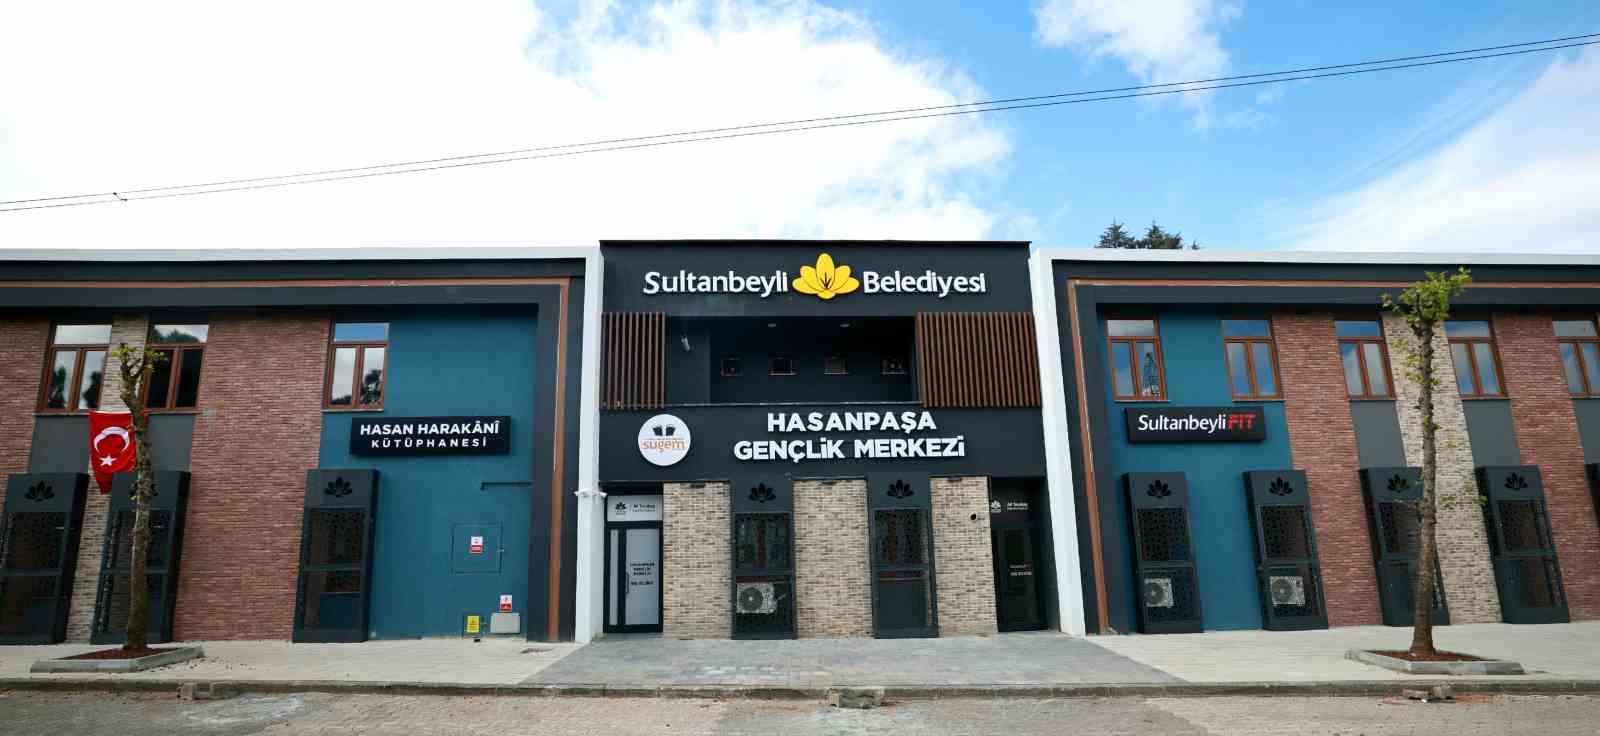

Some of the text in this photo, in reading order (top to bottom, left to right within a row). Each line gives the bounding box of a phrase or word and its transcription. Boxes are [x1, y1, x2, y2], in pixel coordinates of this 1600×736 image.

[643, 270, 987, 298] Sultanbeyli Belediyesi
[360, 420, 500, 435] HASAN HARAKÂNÎ
[767, 410, 937, 434] HASANPAŞA
[371, 436, 487, 449] KÜTÜPHANESİ
[733, 435, 965, 463] GENÇLİK MERKEZİ
